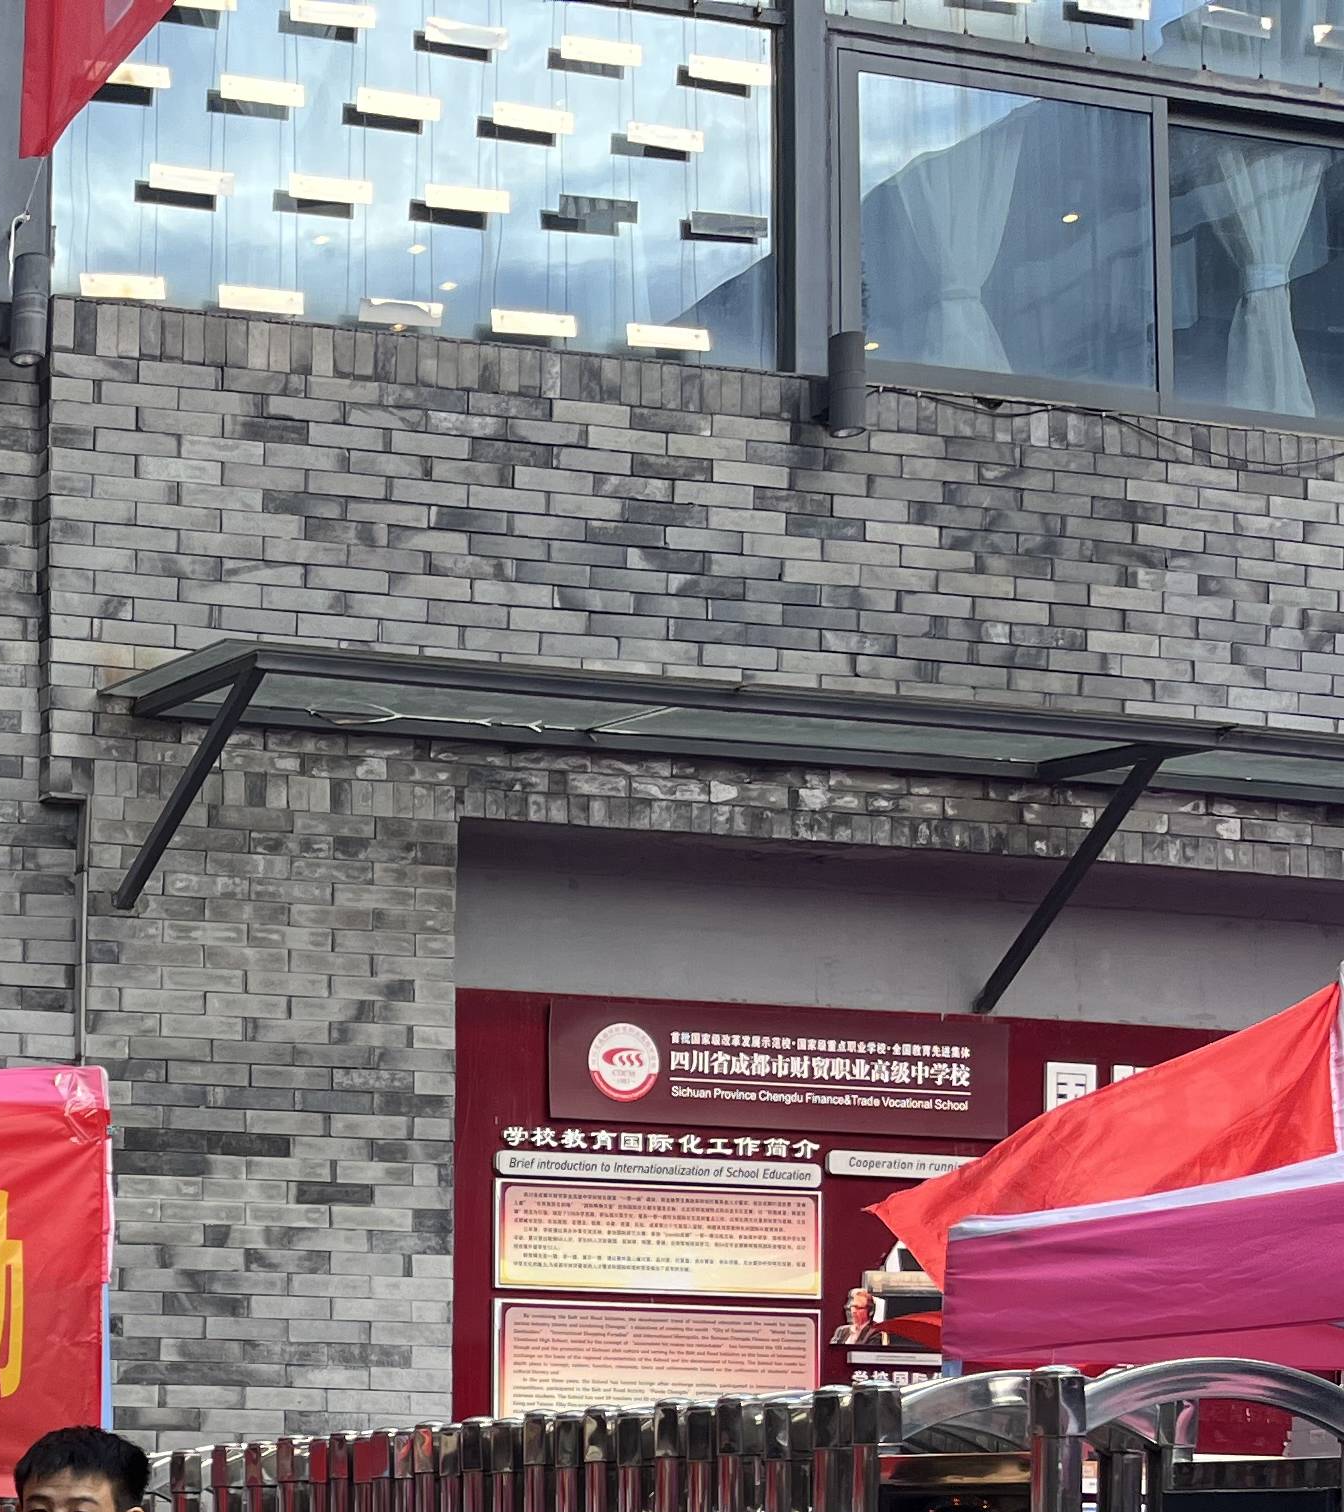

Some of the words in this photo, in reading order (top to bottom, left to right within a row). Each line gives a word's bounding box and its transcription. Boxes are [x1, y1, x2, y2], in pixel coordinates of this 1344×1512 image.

[670, 1050, 971, 1087] 四川省成都市财贸职业高级中学校
[671, 1086, 712, 1099] Sichuan
[713, 1087, 757, 1101] Province
[758, 1089, 804, 1105] Chengdu
[806, 1093, 880, 1107] Finance&Trade
[882, 1095, 933, 1109] Vocational
[935, 1098, 969, 1111] School
[503, 1126, 820, 1159] 学校教育国际化工作简介
[509, 1156, 531, 1169] Brief
[536, 1158, 598, 1172] introduction
[600, 1162, 610, 1172] to
[613, 1163, 710, 1178] Internationalization
[713, 1166, 724, 1178] of
[726, 1166, 759, 1179] School
[762, 1168, 811, 1182] Education
[849, 1156, 914, 1173] Cooperation
[916, 1159, 927, 1171] in
